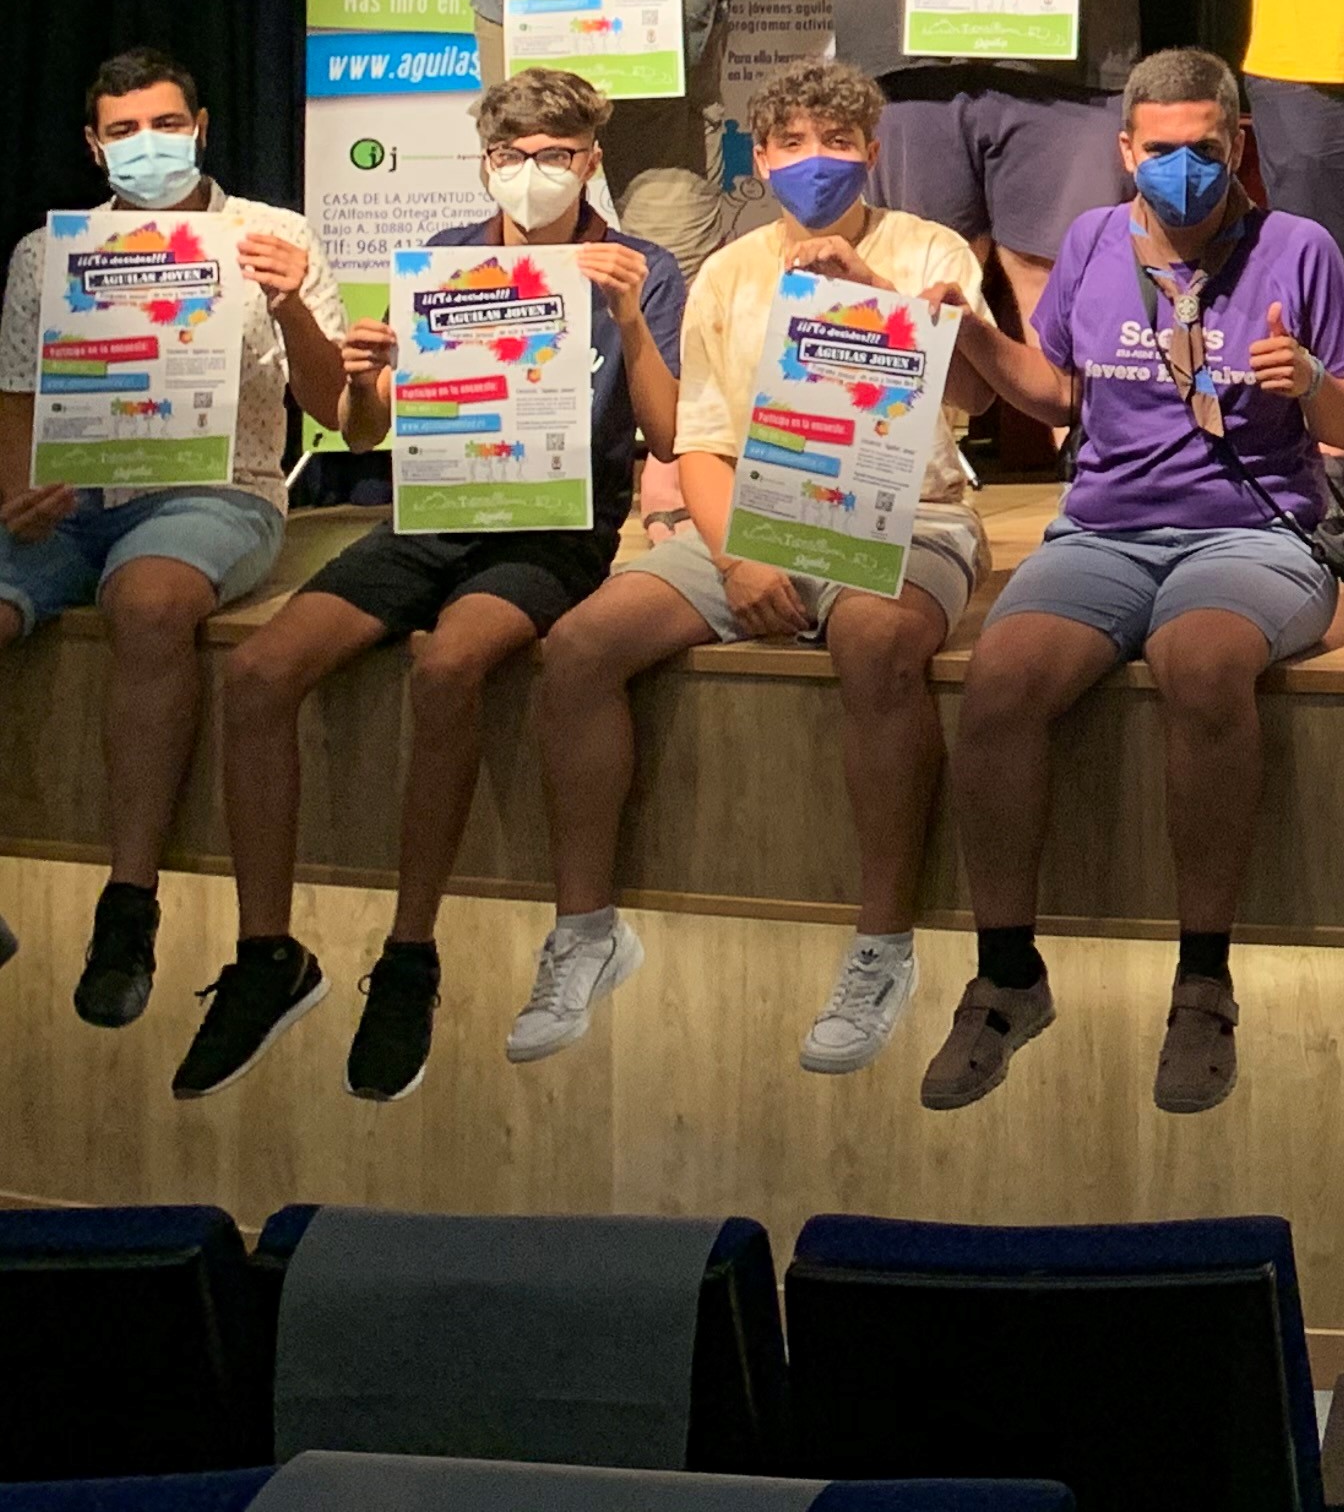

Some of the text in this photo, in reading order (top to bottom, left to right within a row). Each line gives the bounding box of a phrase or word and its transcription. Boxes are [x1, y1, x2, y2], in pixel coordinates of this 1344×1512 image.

[749, 0, 832, 16] jóvenes aguile
[729, 20, 790, 33] programar
[328, 45, 482, 83] www.aguilas
[728, 50, 771, 64] Para ello
[323, 194, 358, 205] CASA
[364, 194, 380, 204] DE
[385, 193, 400, 204] LA
[405, 192, 475, 204] JUVENTUD
[323, 207, 492, 220] C/Alfonso Ortega Carmon
[323, 223, 355, 237] Bajo
[357, 223, 369, 234] A.
[376, 223, 413, 233] 30880
[325, 240, 350, 254] Tlf:
[357, 239, 388, 254] 968
[1120, 320, 1225, 350] Scos
